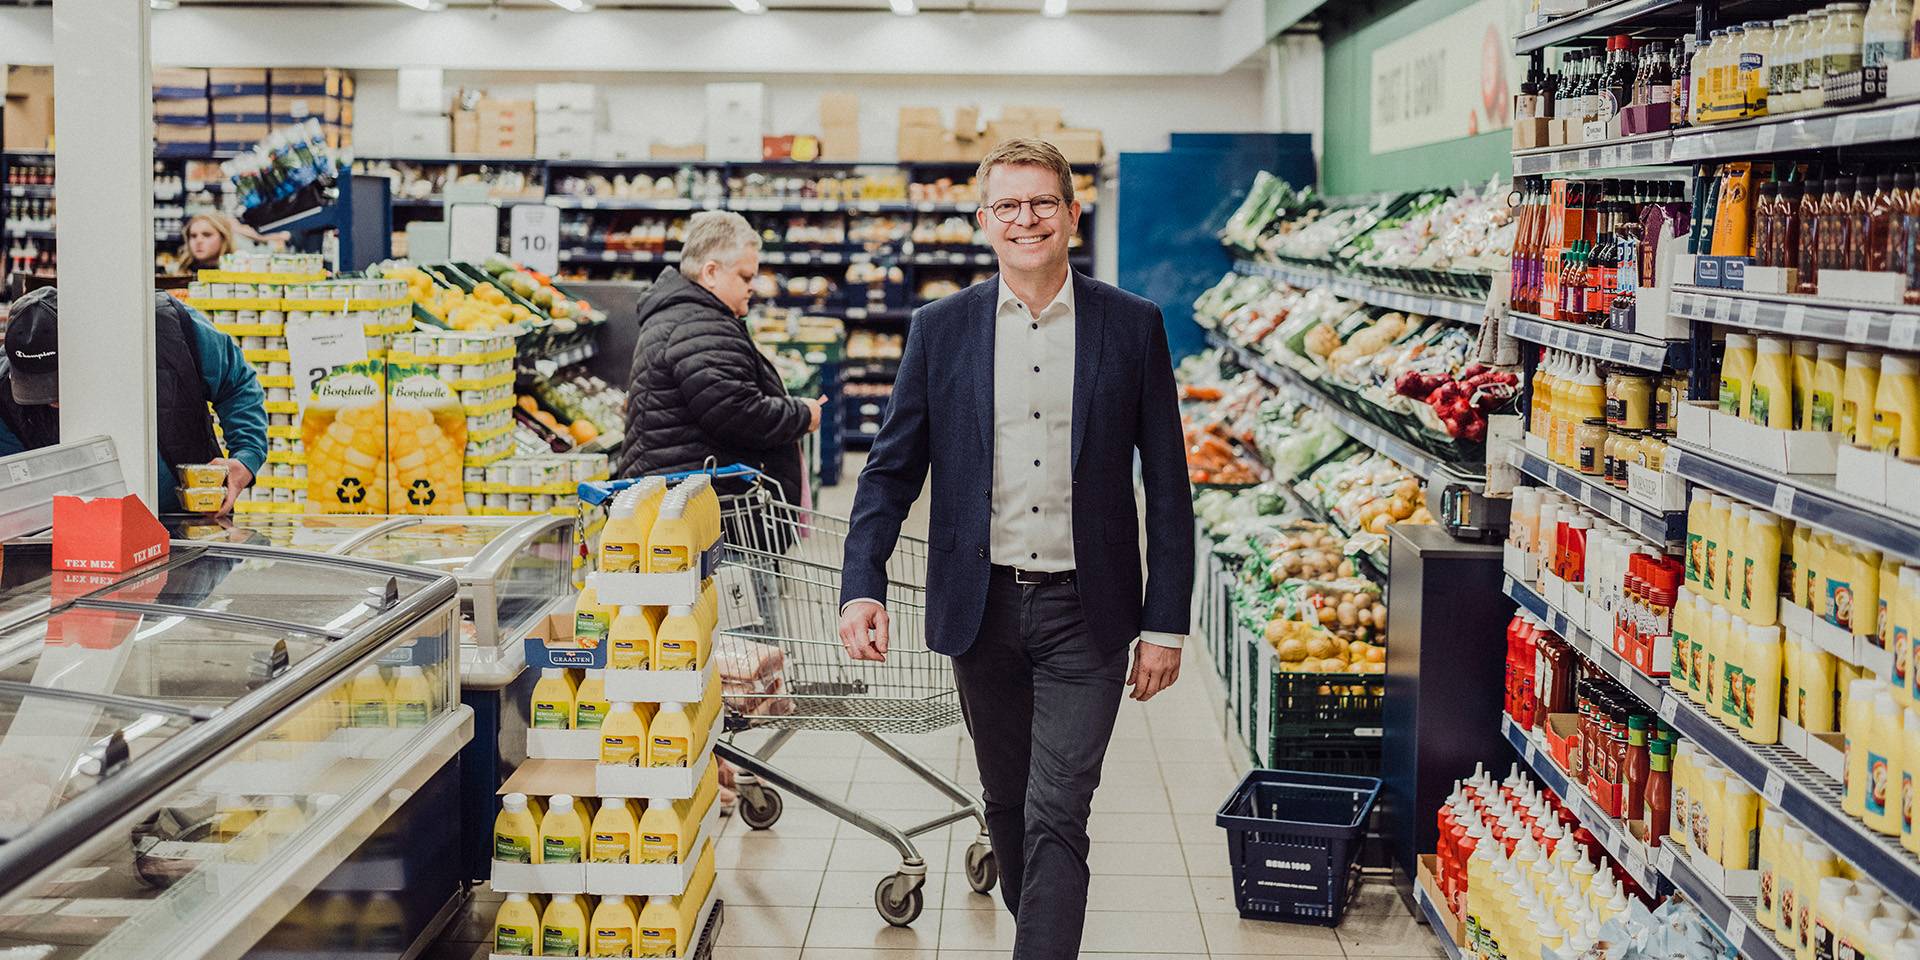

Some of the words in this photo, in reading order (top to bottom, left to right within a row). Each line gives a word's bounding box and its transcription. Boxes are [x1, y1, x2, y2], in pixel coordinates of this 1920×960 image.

[322, 385, 376, 398] Bonduelle
[396, 385, 446, 399] Bonduelle
[133, 552, 147, 563] TEX
[147, 544, 162, 557] MEX
[65, 559, 87, 568] TEX
[90, 560, 115, 569] MEX
